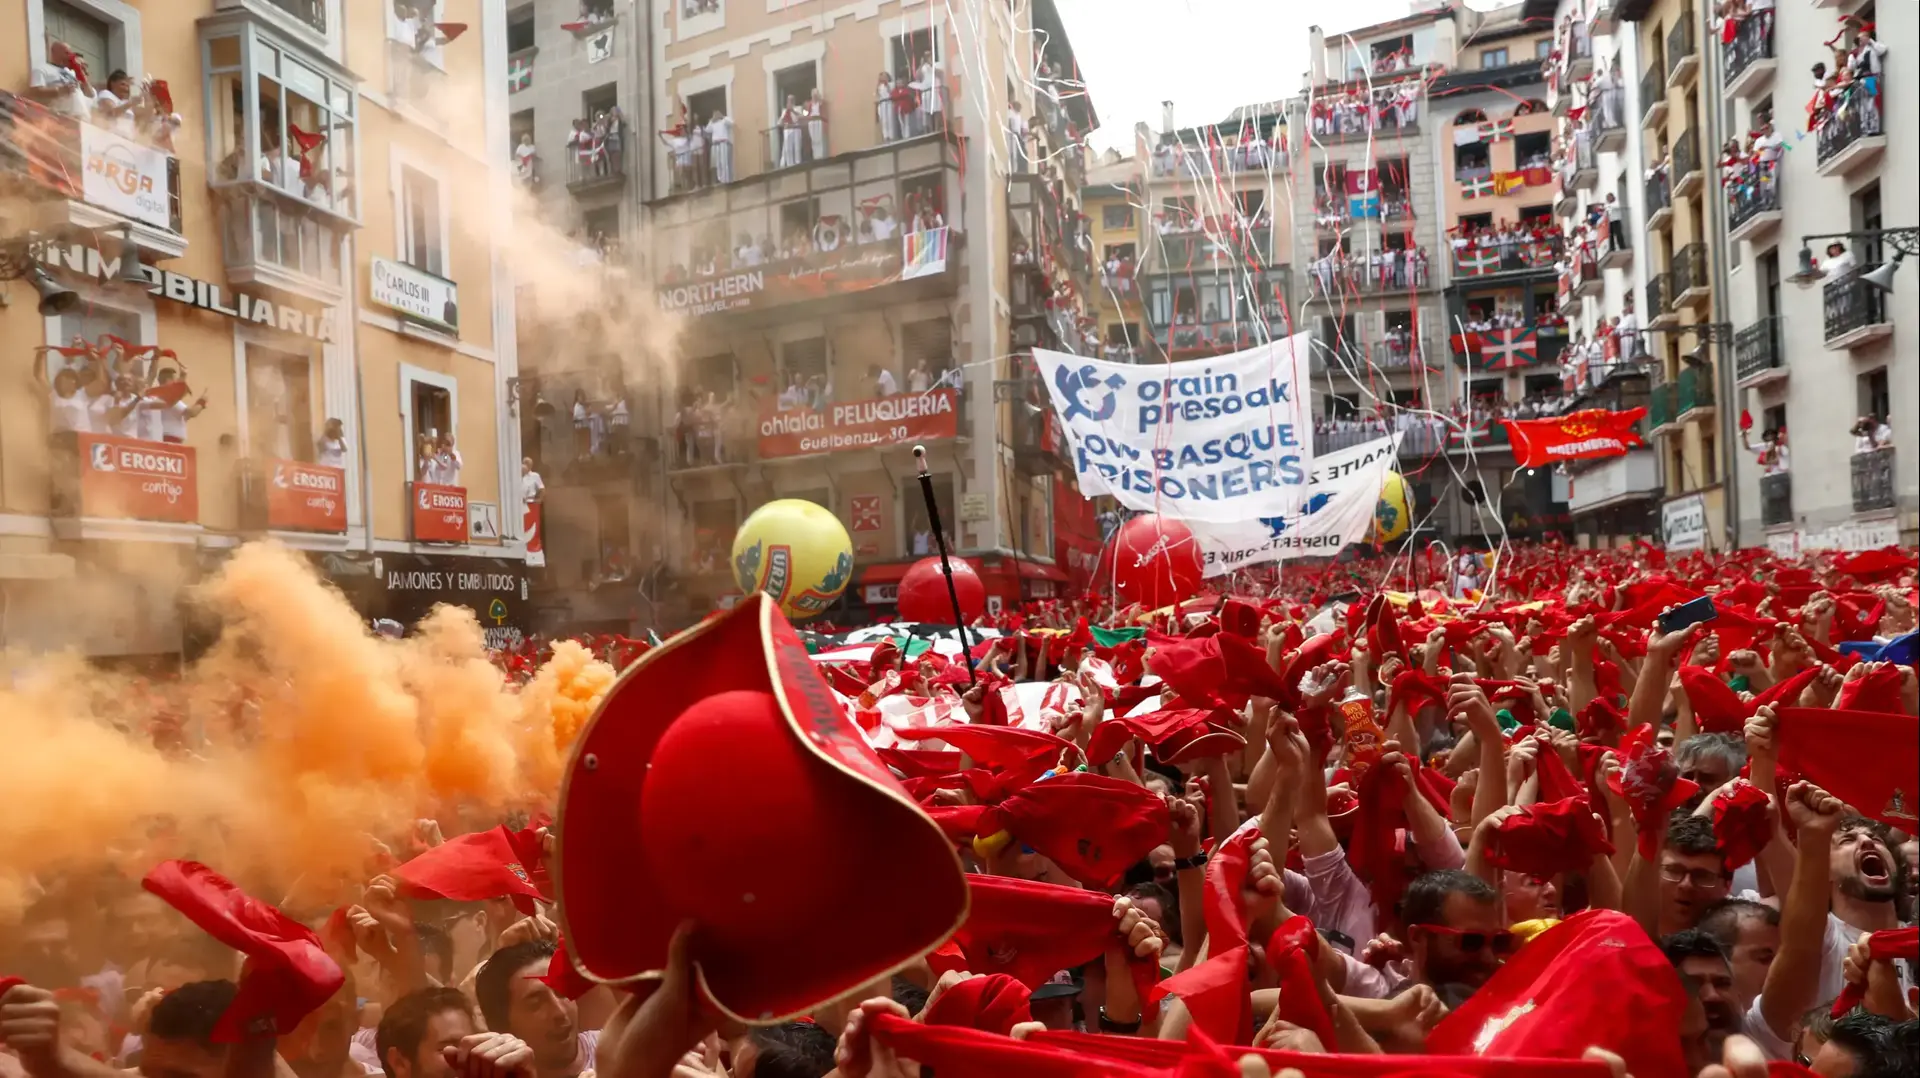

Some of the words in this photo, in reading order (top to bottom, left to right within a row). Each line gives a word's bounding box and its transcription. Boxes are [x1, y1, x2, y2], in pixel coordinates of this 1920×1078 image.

[386, 273, 420, 299] CARLOS
[659, 270, 764, 309] NORTHERN
[1137, 368, 1237, 401] orain
[761, 413, 825, 437] ohlala!
[833, 392, 952, 426] PELUQUERIA
[1138, 378, 1291, 433] presoak
[889, 426, 908, 441] 30
[1073, 429, 1140, 461] OW
[1151, 424, 1299, 470] BASQUE
[120, 451, 183, 474] EROSKI
[141, 478, 183, 504] contigo
[292, 471, 337, 491] EROSKI
[432, 494, 464, 509] EROSKI
[387, 571, 442, 591] JAMONES
[445, 572, 455, 591] Y
[458, 572, 515, 592] EMBUTIDOS
